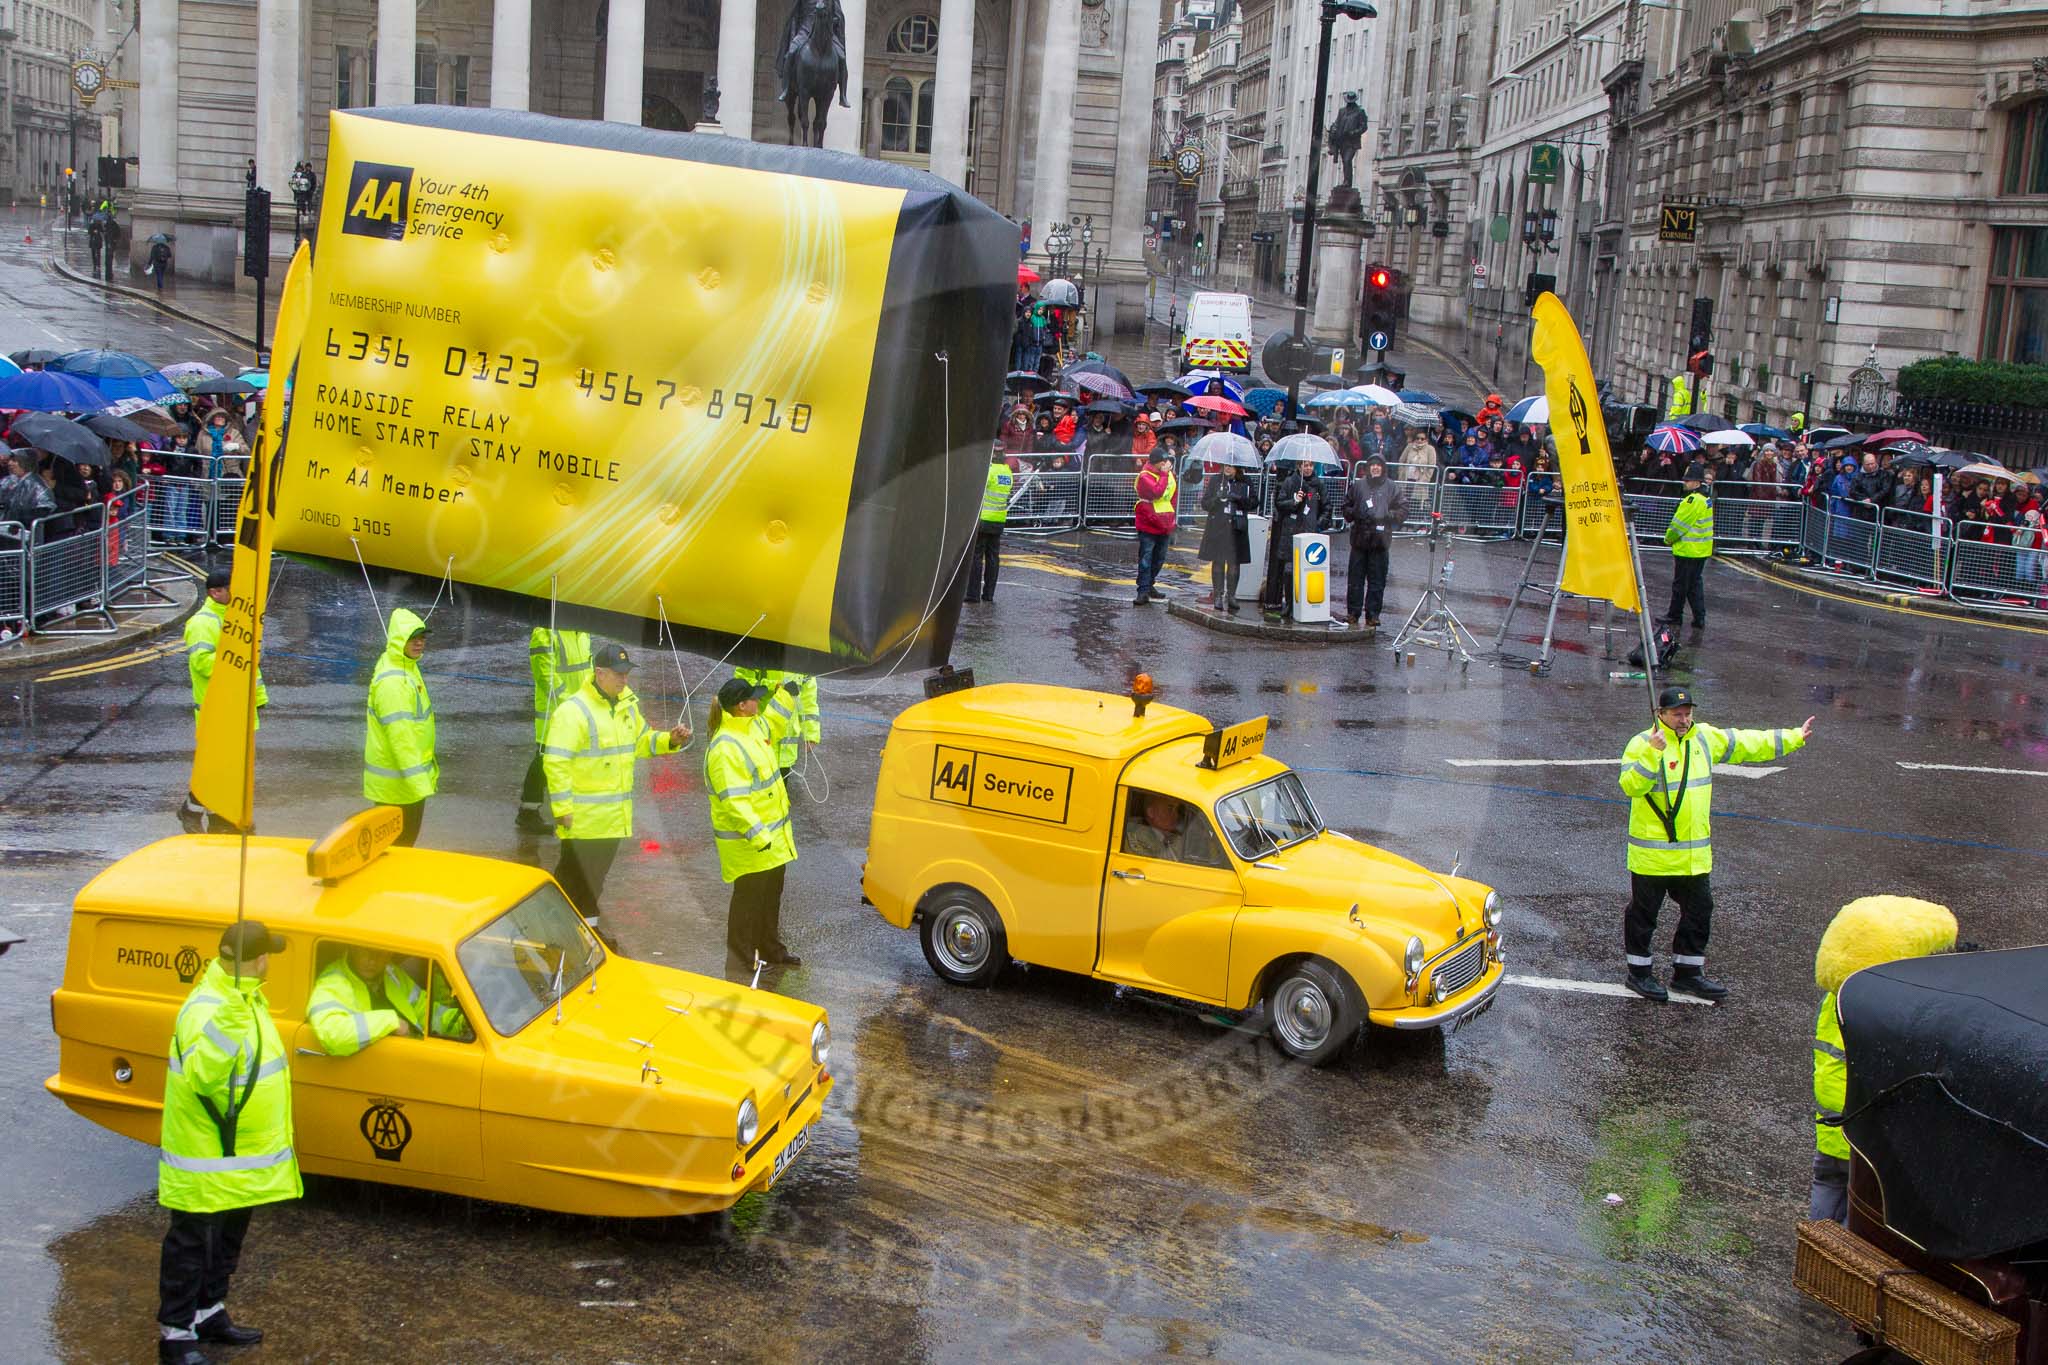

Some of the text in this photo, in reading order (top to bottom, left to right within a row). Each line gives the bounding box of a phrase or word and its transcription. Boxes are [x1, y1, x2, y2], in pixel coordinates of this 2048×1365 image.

[350, 177, 402, 223] AA
[417, 177, 489, 201] Your 4th
[410, 218, 464, 240] Service
[413, 198, 504, 230] Emergency
[328, 291, 461, 324] MEMBERSHIP NUMBER
[325, 327, 812, 433] 6356 0123 4567 8910
[316, 384, 511, 433] ROADSIDE RELAY
[314, 410, 621, 482] HOME START STAY MOBILE
[307, 459, 464, 504] Mr AA Member
[299, 508, 392, 537] JOINED 1905
[1222, 731, 1264, 758] AA Service
[935, 760, 1055, 802] AA Service
[374, 815, 401, 844] SERVICE
[117, 947, 172, 969] PATROL
